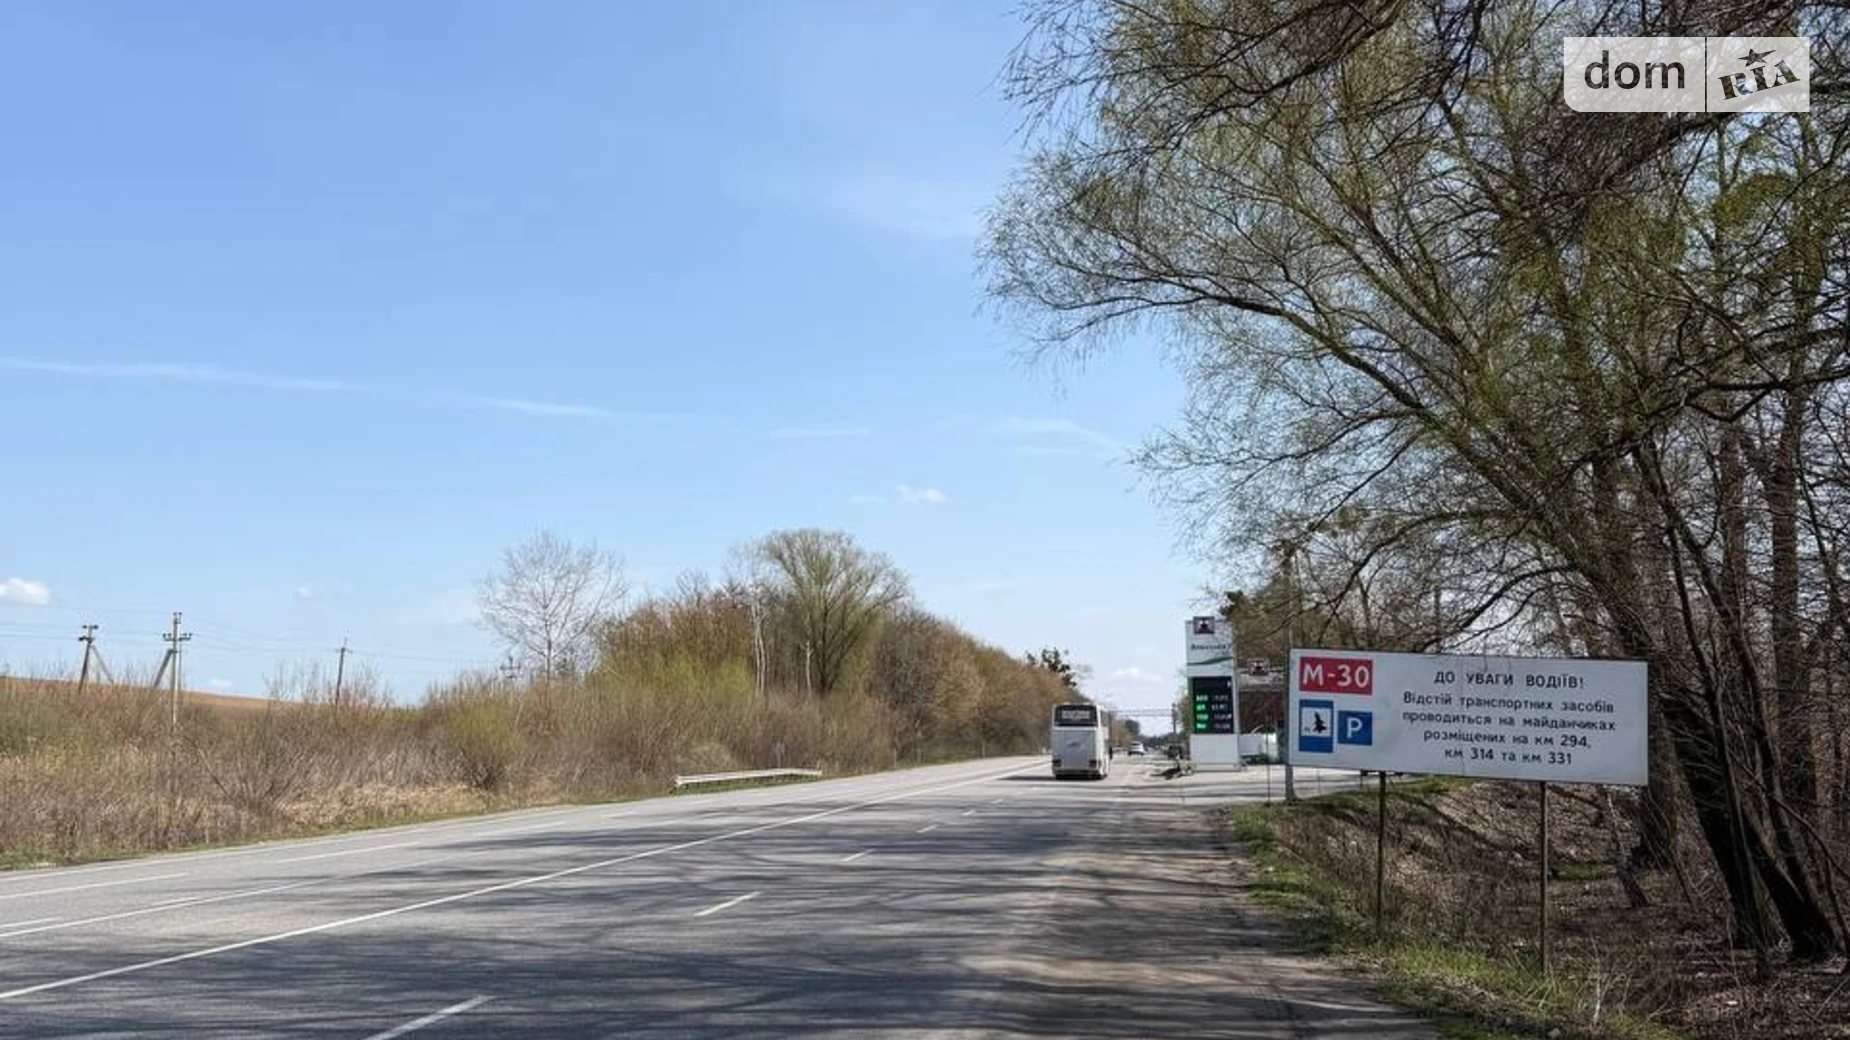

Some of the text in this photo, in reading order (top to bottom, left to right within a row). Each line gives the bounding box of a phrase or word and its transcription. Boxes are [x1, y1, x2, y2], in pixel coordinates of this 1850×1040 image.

[1302, 663, 1370, 688] М-30
[1433, 671, 1585, 689] ДО УВАГИ ВОДІЇВ!
[1403, 691, 1615, 714] Відстій транспортних засобів
[1346, 717, 1363, 739] P
[1402, 711, 1617, 731] проводиться на майданчиках
[1423, 730, 1592, 748] розміщених на км 294,
[1445, 747, 1572, 765] км 314 та км 331
